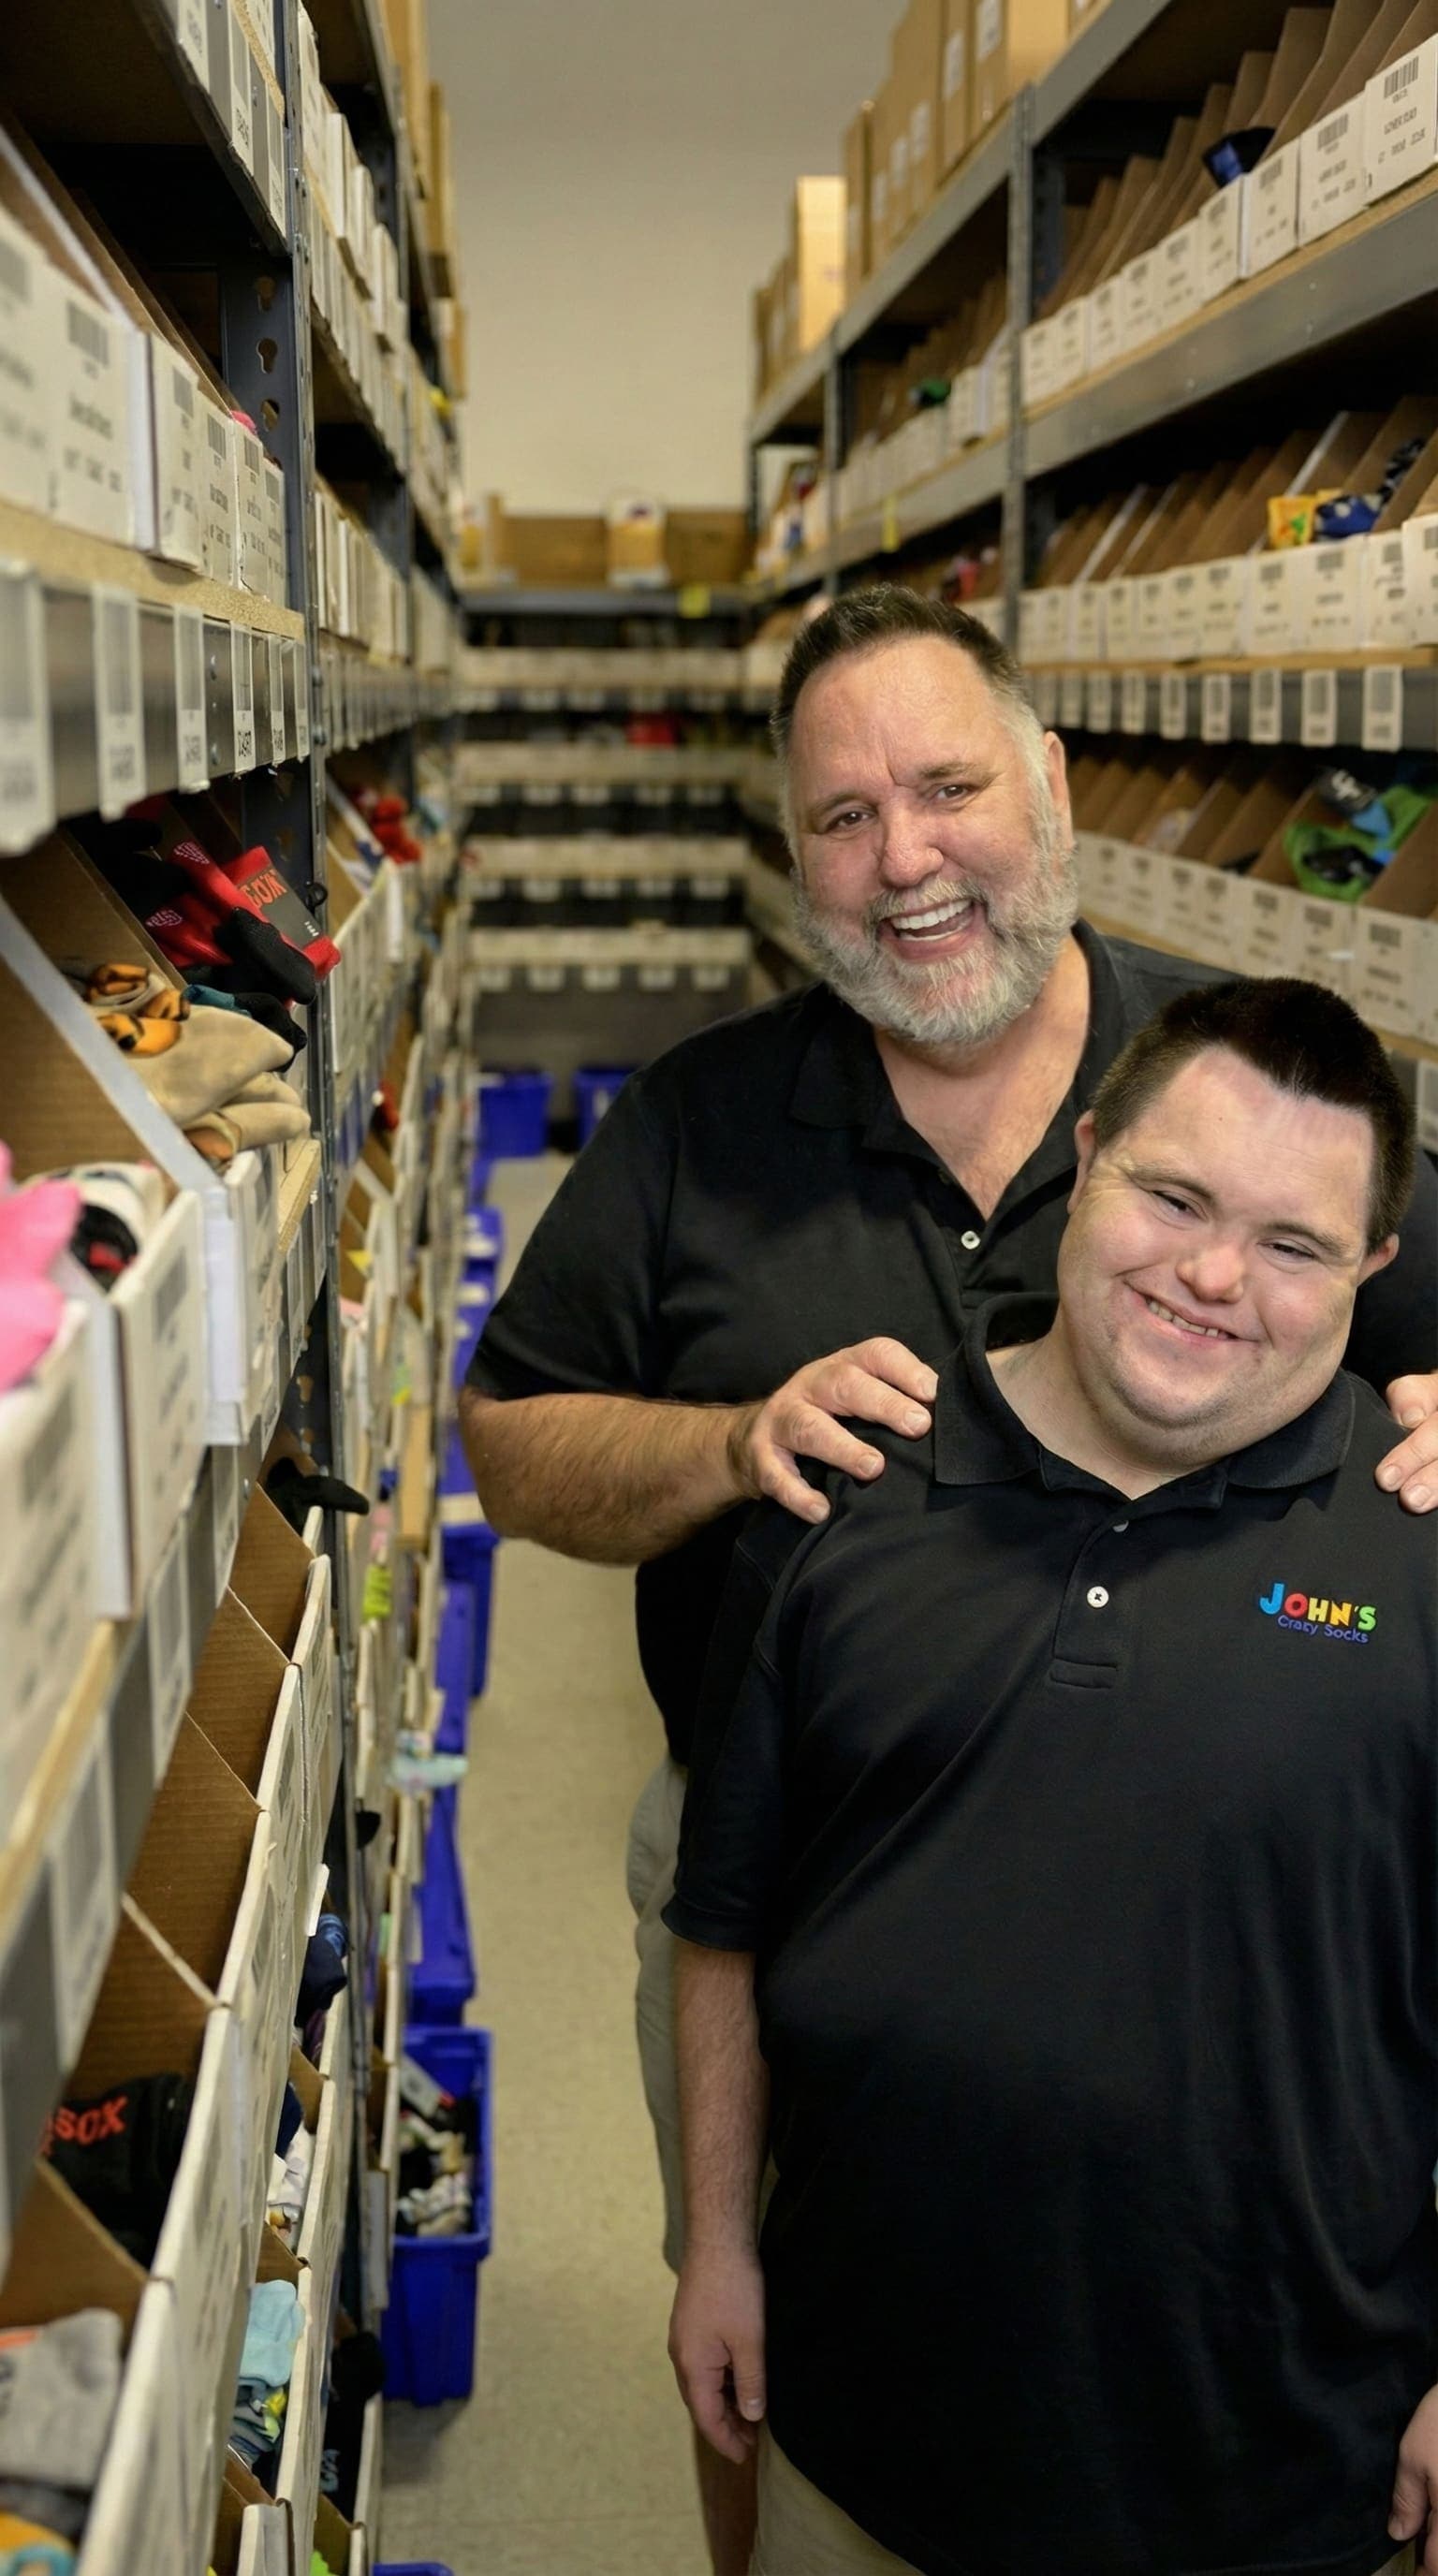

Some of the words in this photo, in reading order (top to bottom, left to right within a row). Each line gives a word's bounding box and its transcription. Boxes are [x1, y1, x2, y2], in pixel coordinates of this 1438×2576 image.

[1259, 1582, 1377, 1632] JOHN'S
[1278, 1615, 1319, 1636] Crazy
[1323, 1624, 1369, 1645] Socks
